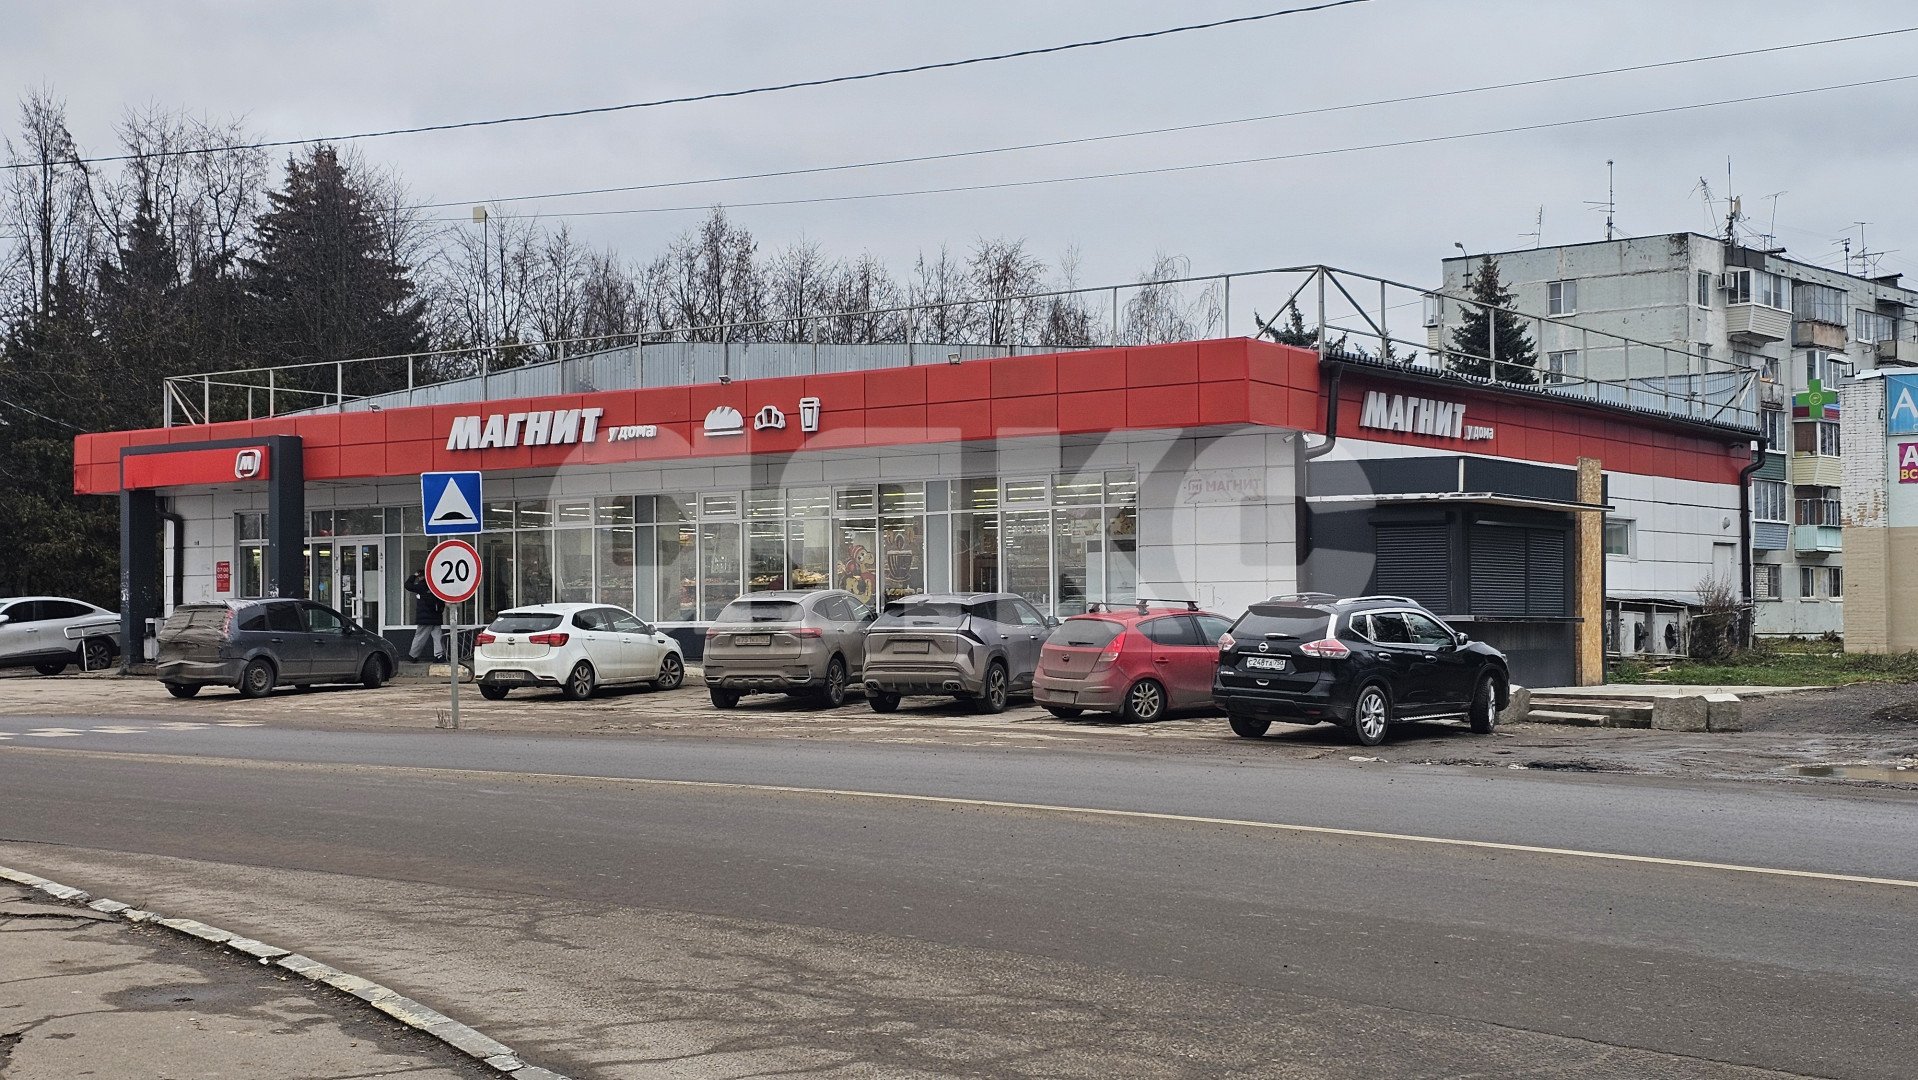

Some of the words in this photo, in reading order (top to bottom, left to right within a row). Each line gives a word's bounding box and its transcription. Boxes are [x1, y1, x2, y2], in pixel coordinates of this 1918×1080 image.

[446, 407, 604, 450] МАГНИТ
[608, 427, 619, 442] у
[618, 425, 658, 440] дома
[1360, 391, 1466, 439] МАГНИТ
[1473, 426, 1494, 440] дома
[1205, 478, 1262, 493] МАГНИТ
[441, 559, 470, 584] 20
